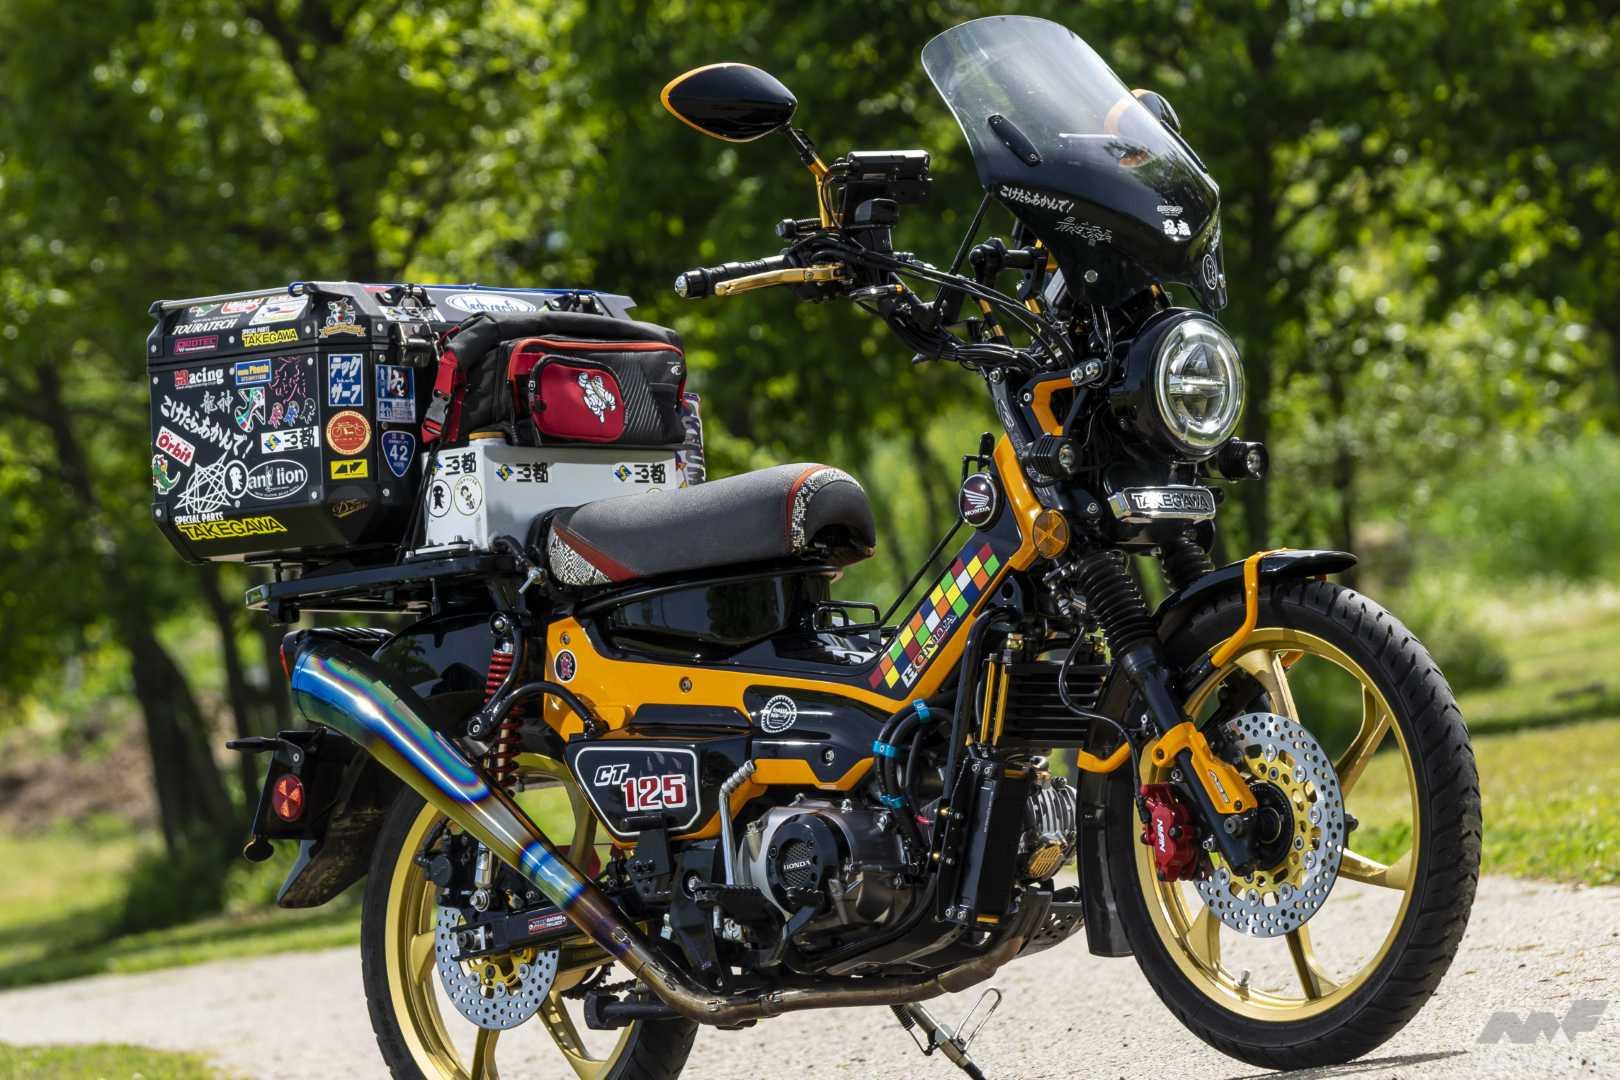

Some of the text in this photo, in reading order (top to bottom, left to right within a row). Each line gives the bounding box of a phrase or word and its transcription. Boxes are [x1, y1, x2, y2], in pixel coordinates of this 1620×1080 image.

[172, 318, 238, 335] TOURATECH
[243, 329, 298, 347] TAKEGAWA
[331, 357, 361, 379] テック
[200, 390, 233, 414] 龍神
[331, 383, 361, 404] サーフ
[158, 433, 192, 463] Orbit
[390, 445, 408, 461] 42
[248, 466, 304, 490] ant lion
[174, 511, 224, 525] SPECIAL PARTS
[964, 506, 990, 516] HONDA
[178, 516, 287, 540] TAKEGAWA
[594, 763, 630, 786] CT
[621, 774, 687, 812] 125
[783, 859, 811, 871] HONDA
